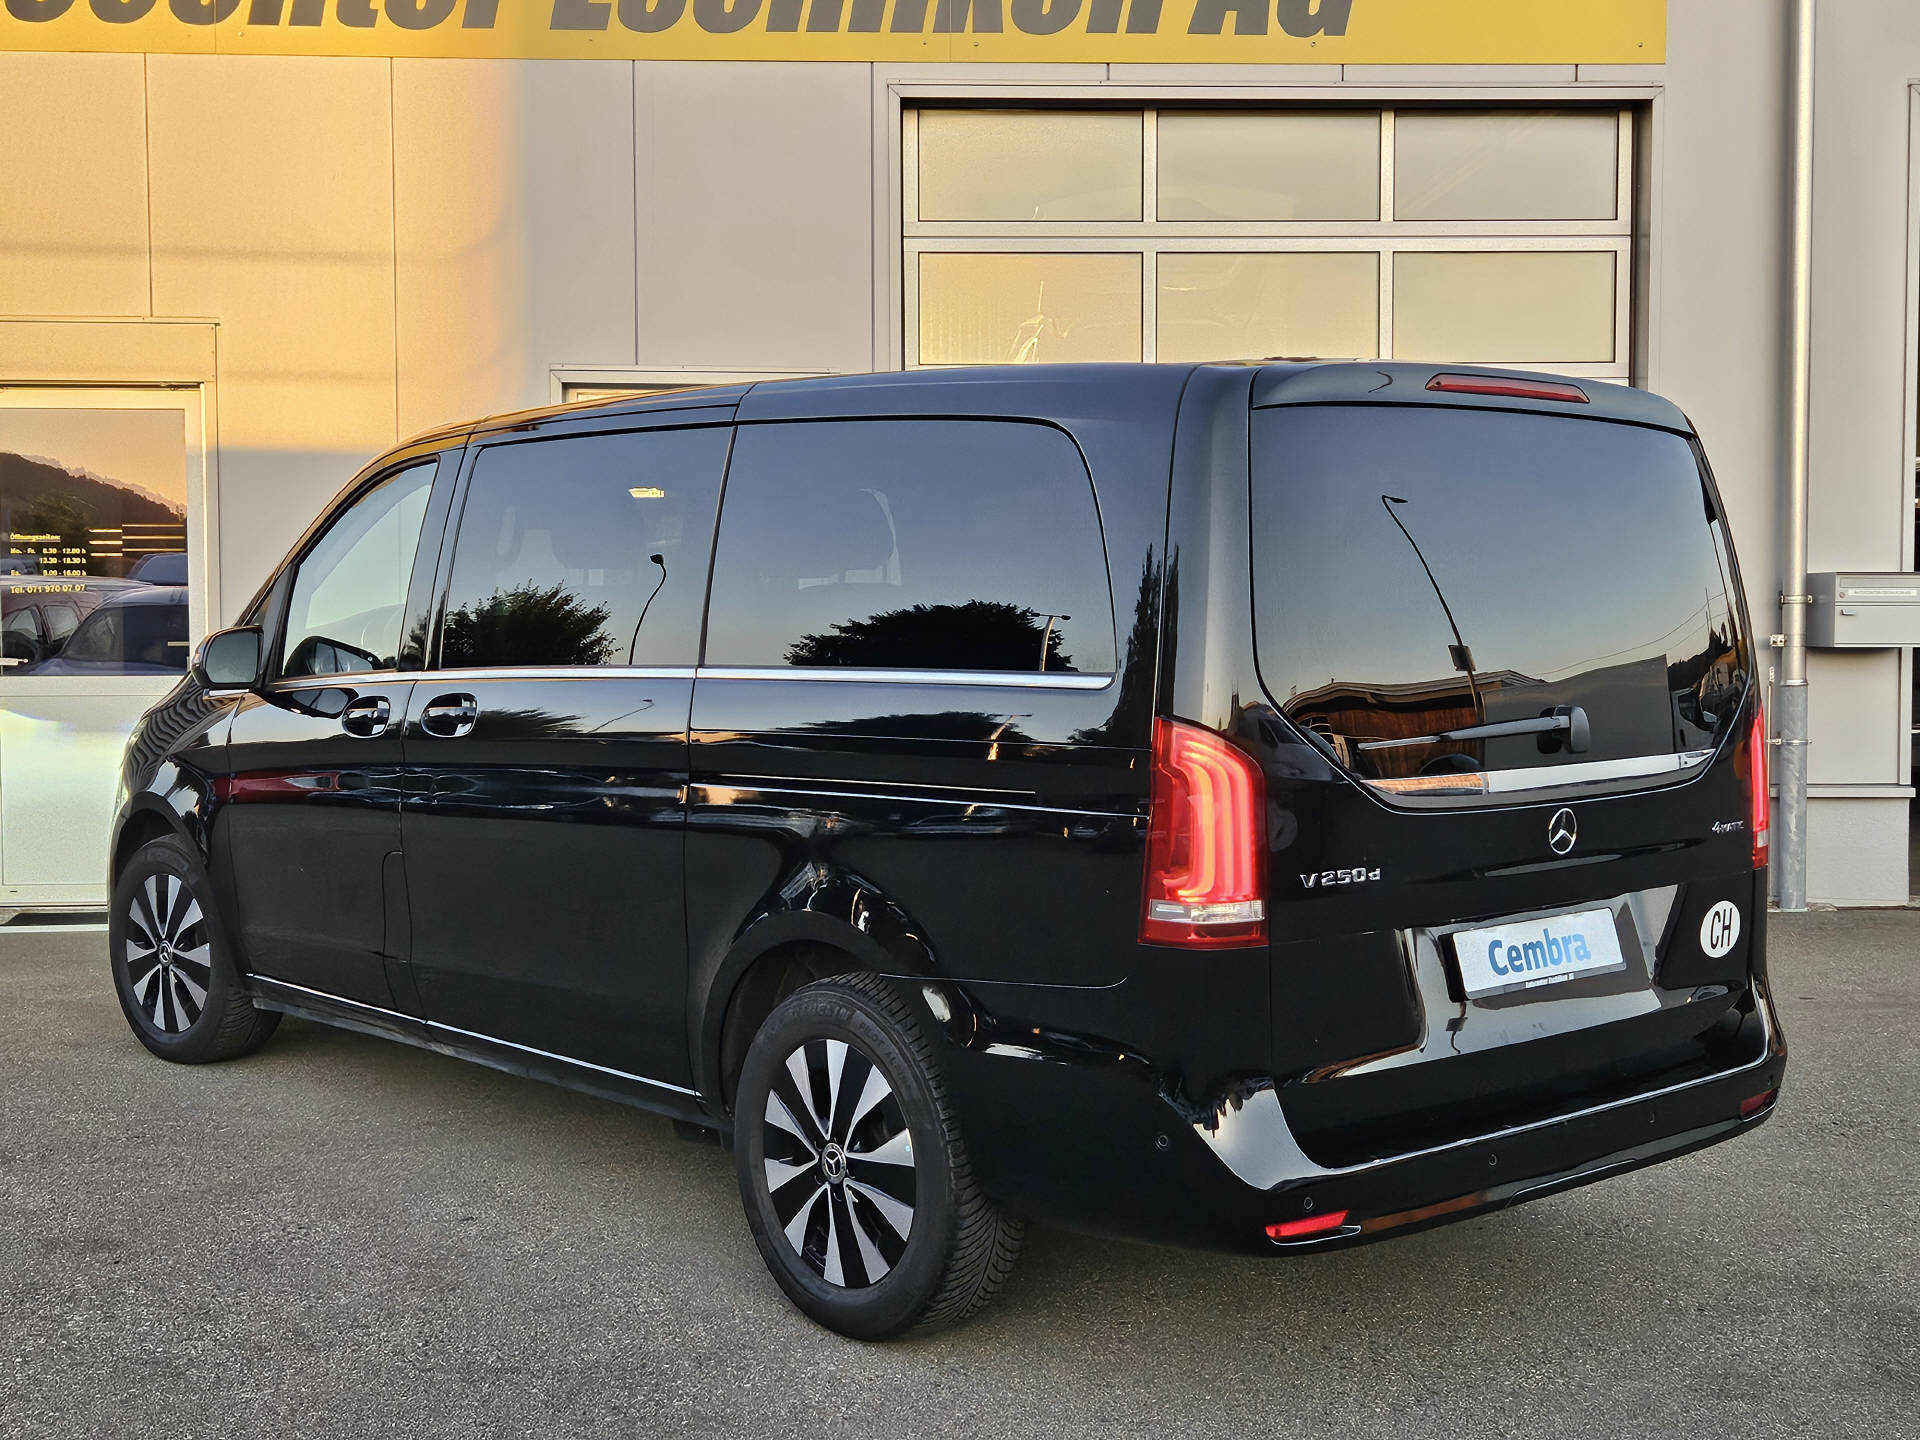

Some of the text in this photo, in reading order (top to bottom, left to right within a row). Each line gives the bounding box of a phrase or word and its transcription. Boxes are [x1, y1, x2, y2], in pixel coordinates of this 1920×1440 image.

[10, 586, 25, 594] Tel.
[26, 585, 42, 593] 071
[44, 585, 61, 593] 970
[74, 584, 86, 592] 07
[1710, 907, 1733, 950] CH
[1487, 927, 1592, 976] Cembra
